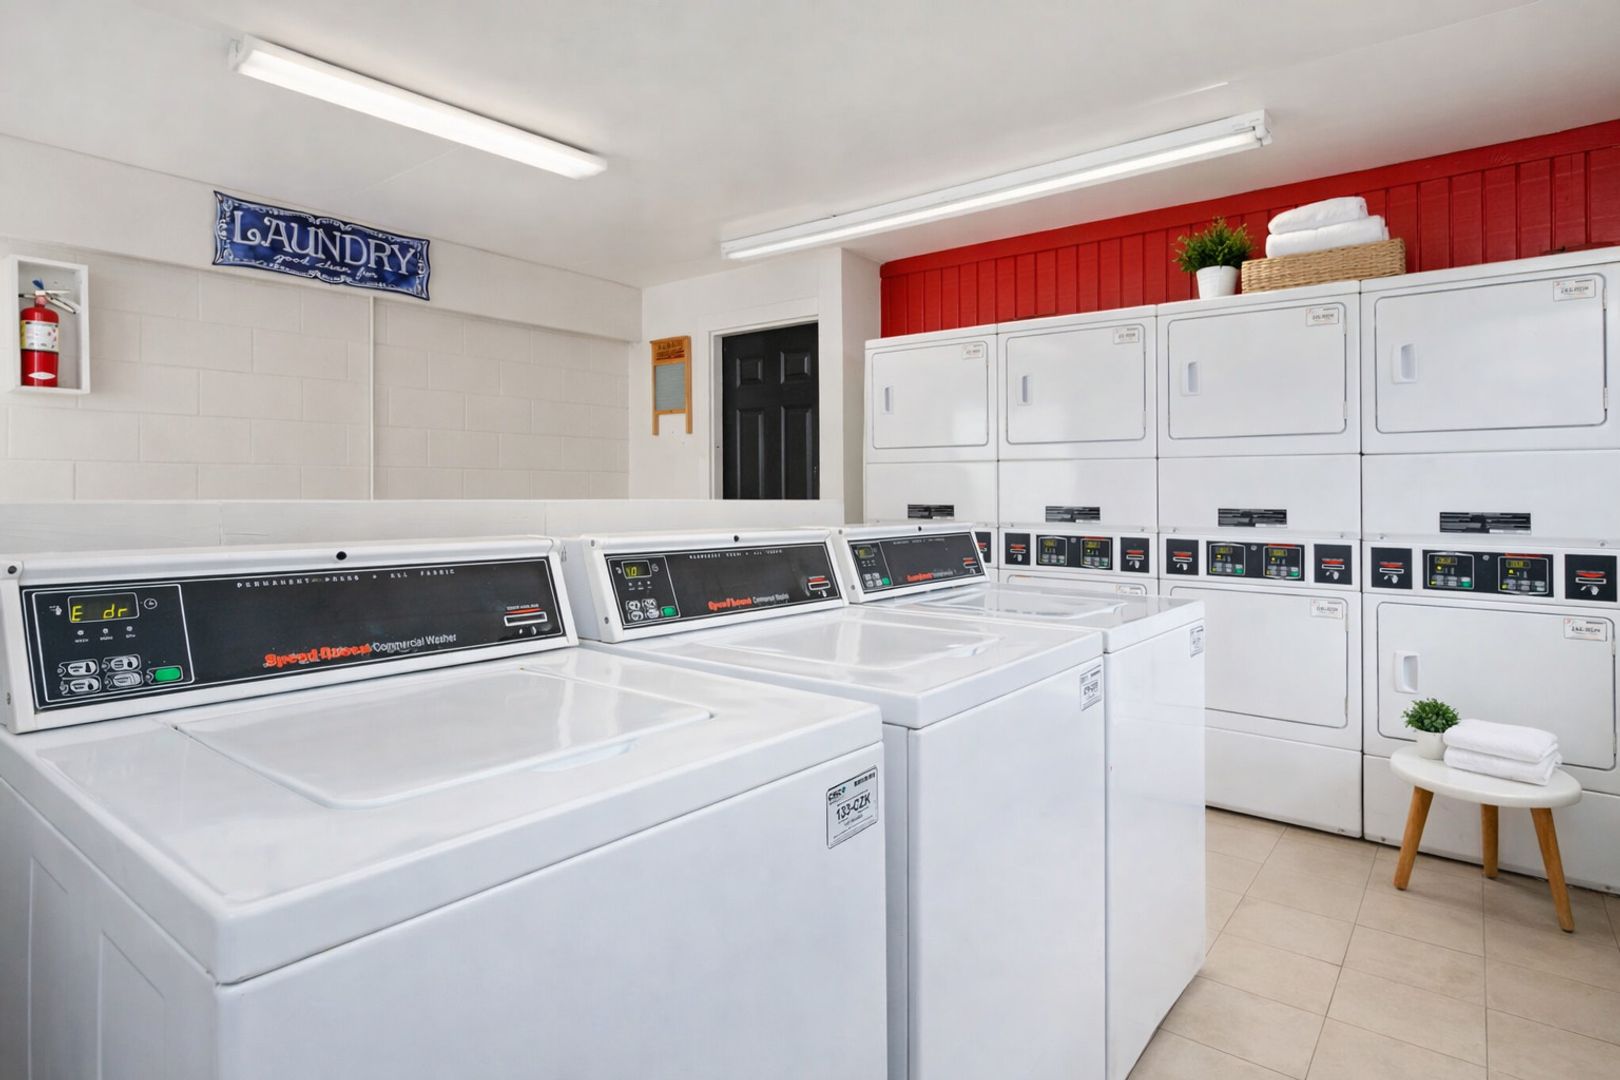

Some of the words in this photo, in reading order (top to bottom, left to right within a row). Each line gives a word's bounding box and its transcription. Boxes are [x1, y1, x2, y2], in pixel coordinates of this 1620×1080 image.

[232, 210, 416, 275] LAUNDRY
[273, 254, 311, 266] good
[315, 261, 351, 274] clean
[355, 266, 378, 280] fun
[71, 605, 84, 622] E
[103, 603, 128, 619] dr
[372, 635, 425, 653] Commercial
[425, 633, 457, 646] Washer
